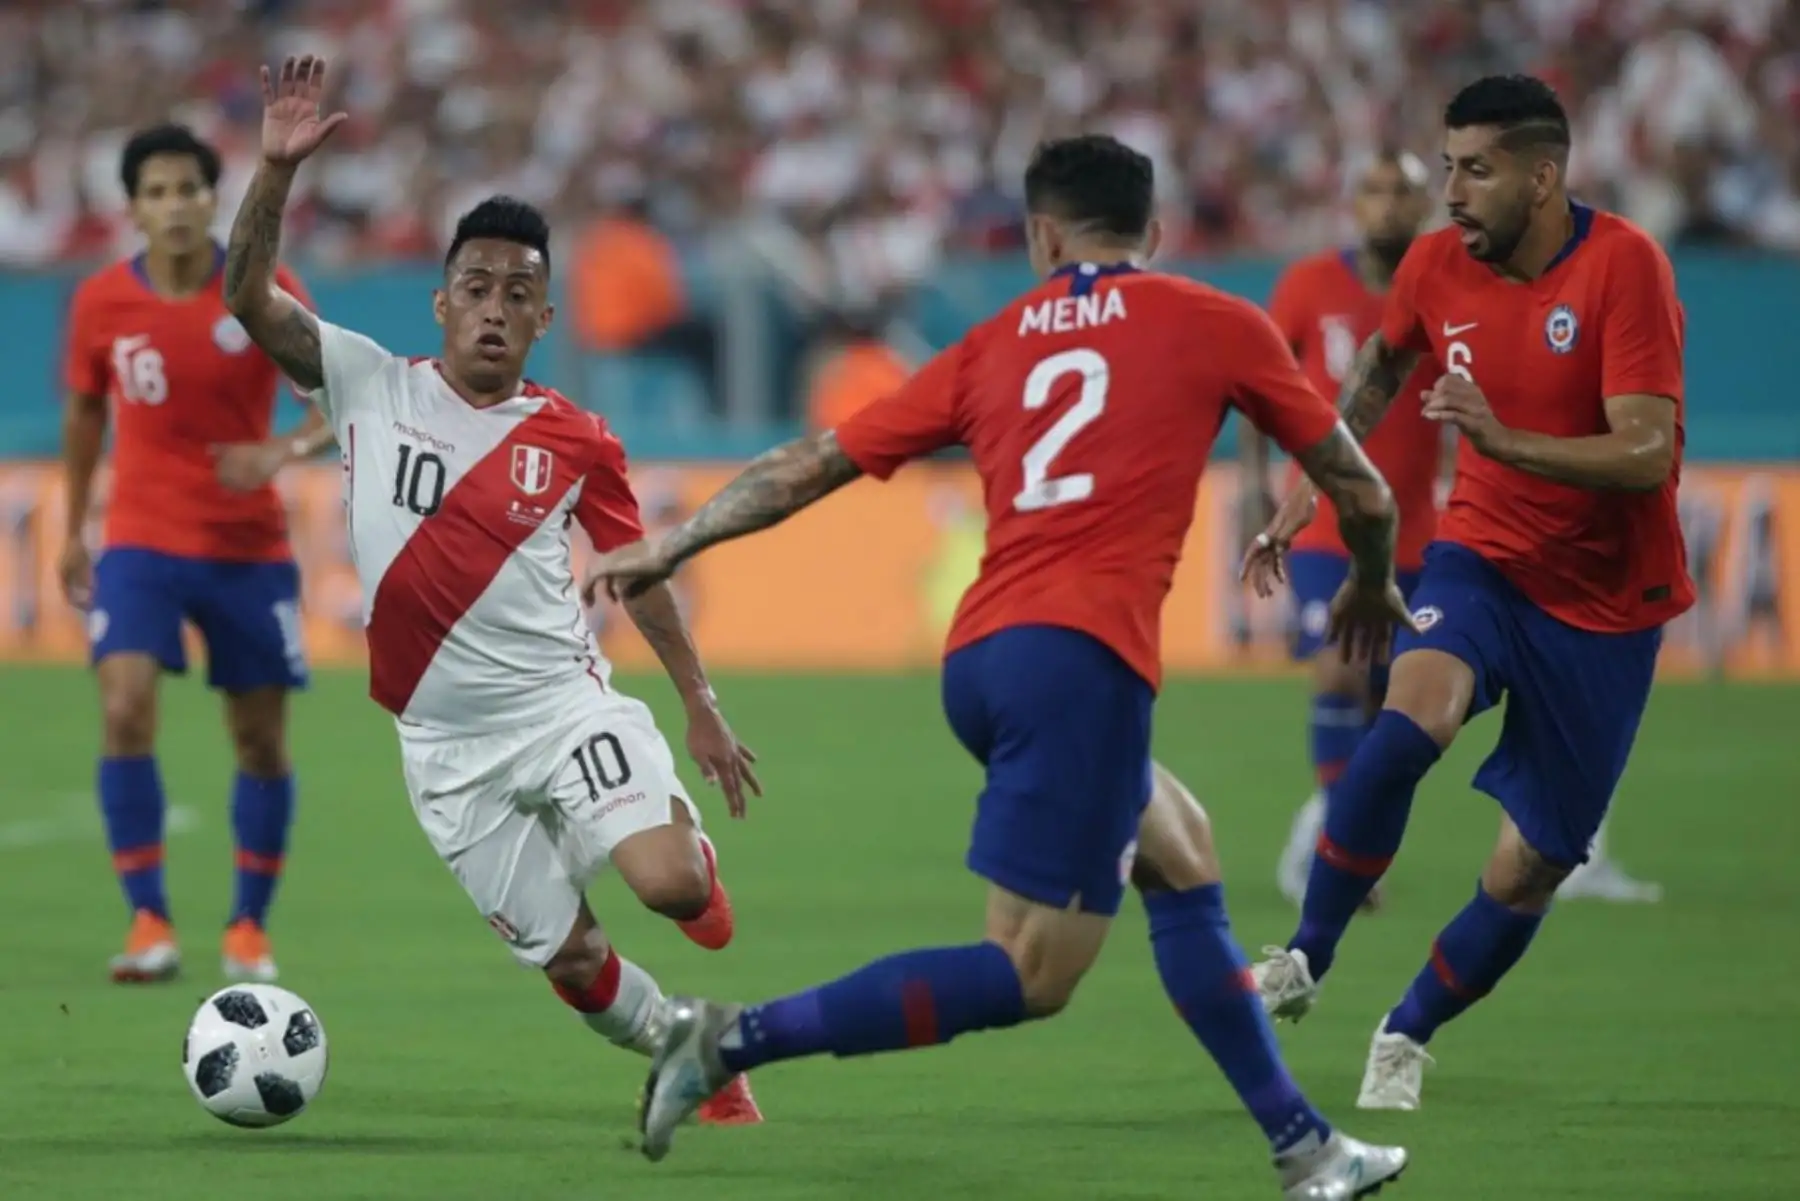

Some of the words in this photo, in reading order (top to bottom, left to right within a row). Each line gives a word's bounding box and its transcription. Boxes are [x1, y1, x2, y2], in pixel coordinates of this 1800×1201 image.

[1017, 287, 1127, 337] MENA
[1012, 348, 1109, 511] 2
[392, 443, 446, 517] 10
[571, 731, 632, 803] 10
